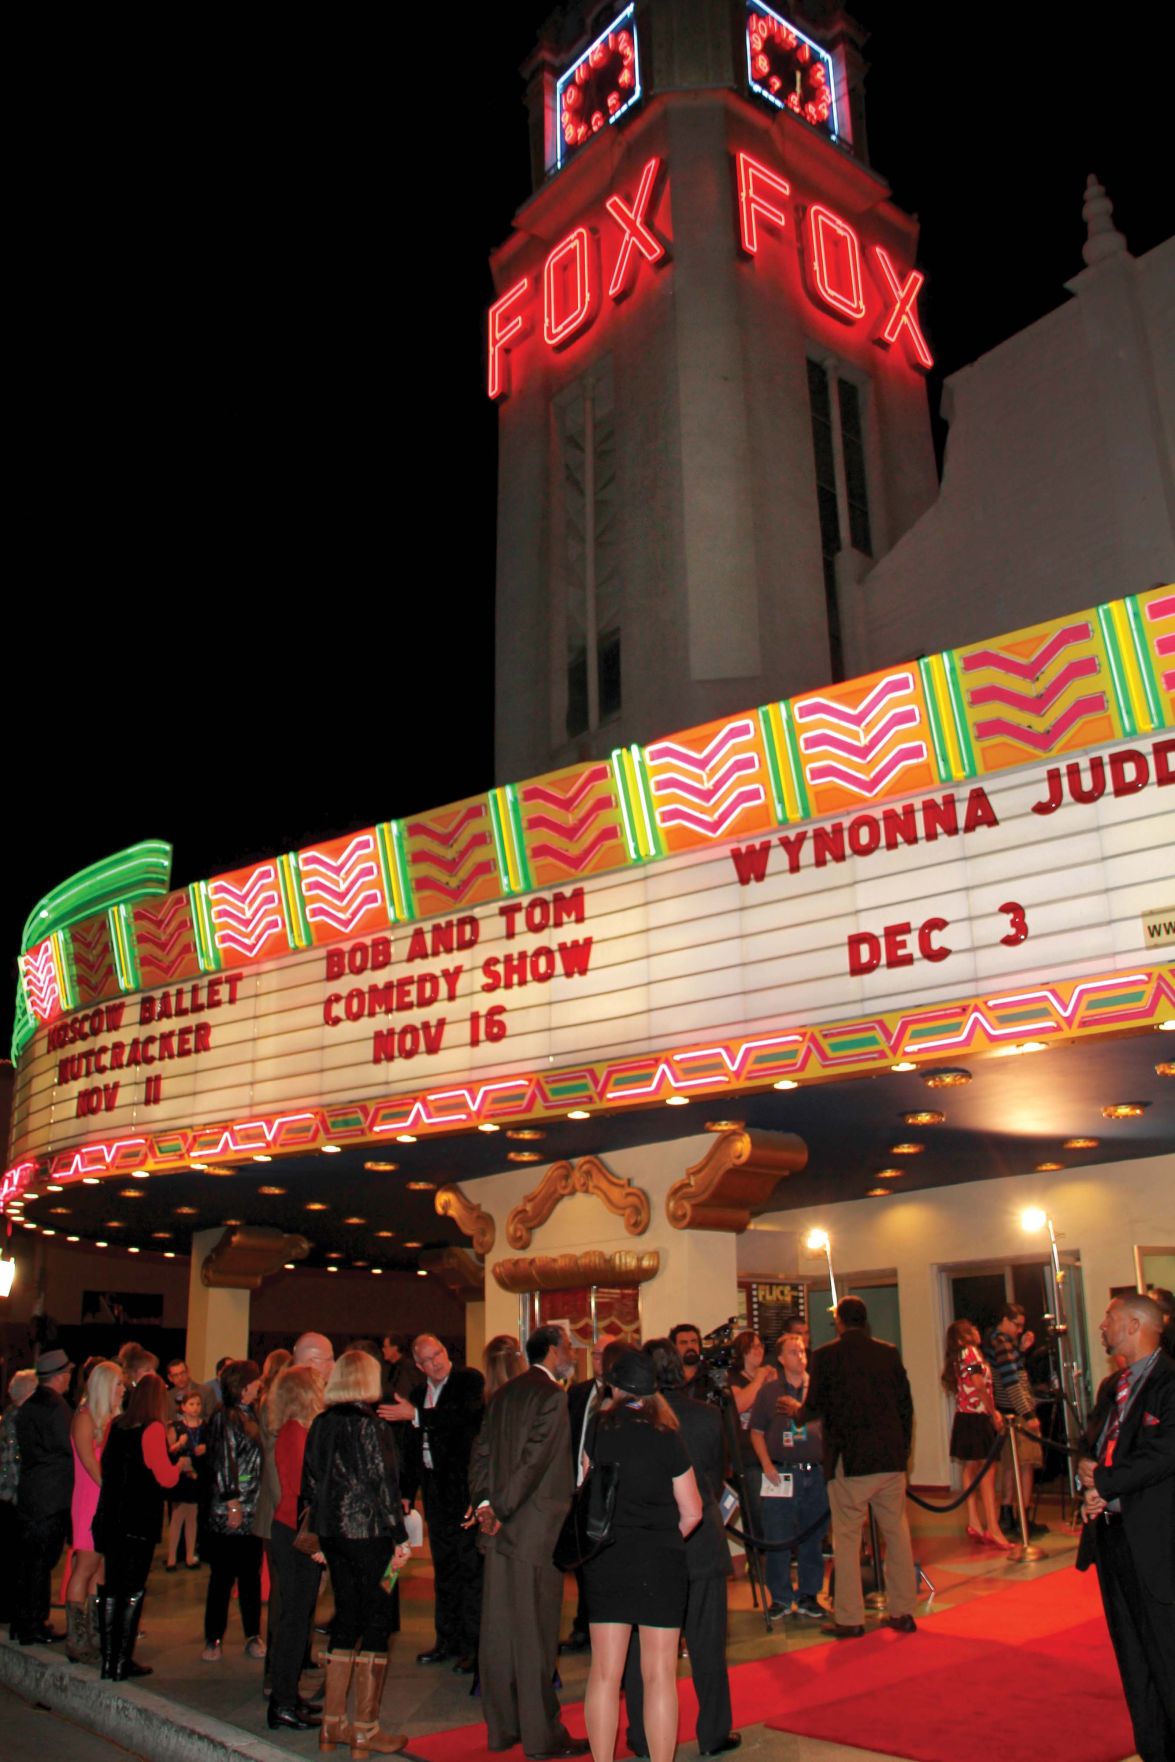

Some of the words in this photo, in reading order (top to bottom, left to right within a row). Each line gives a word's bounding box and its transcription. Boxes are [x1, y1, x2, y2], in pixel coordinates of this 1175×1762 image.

[618, 30, 630, 51] 2
[487, 157, 665, 400] FOX
[737, 152, 934, 370] FOX
[730, 787, 999, 886] WYNONNA
[325, 936, 392, 982] BOB
[406, 915, 480, 963] AND
[499, 887, 585, 940] TOM
[847, 917, 952, 977] DEC
[998, 901, 1029, 947] 3
[47, 1001, 126, 1055] MOSCOW
[140, 972, 244, 1026] BALLET
[323, 965, 463, 1027] COMEDY
[481, 937, 593, 993] SHOW
[58, 1021, 213, 1087] NUTCRACKER
[372, 1017, 446, 1065] NOV
[469, 1005, 507, 1048] 16
[76, 1080, 120, 1119] NOV
